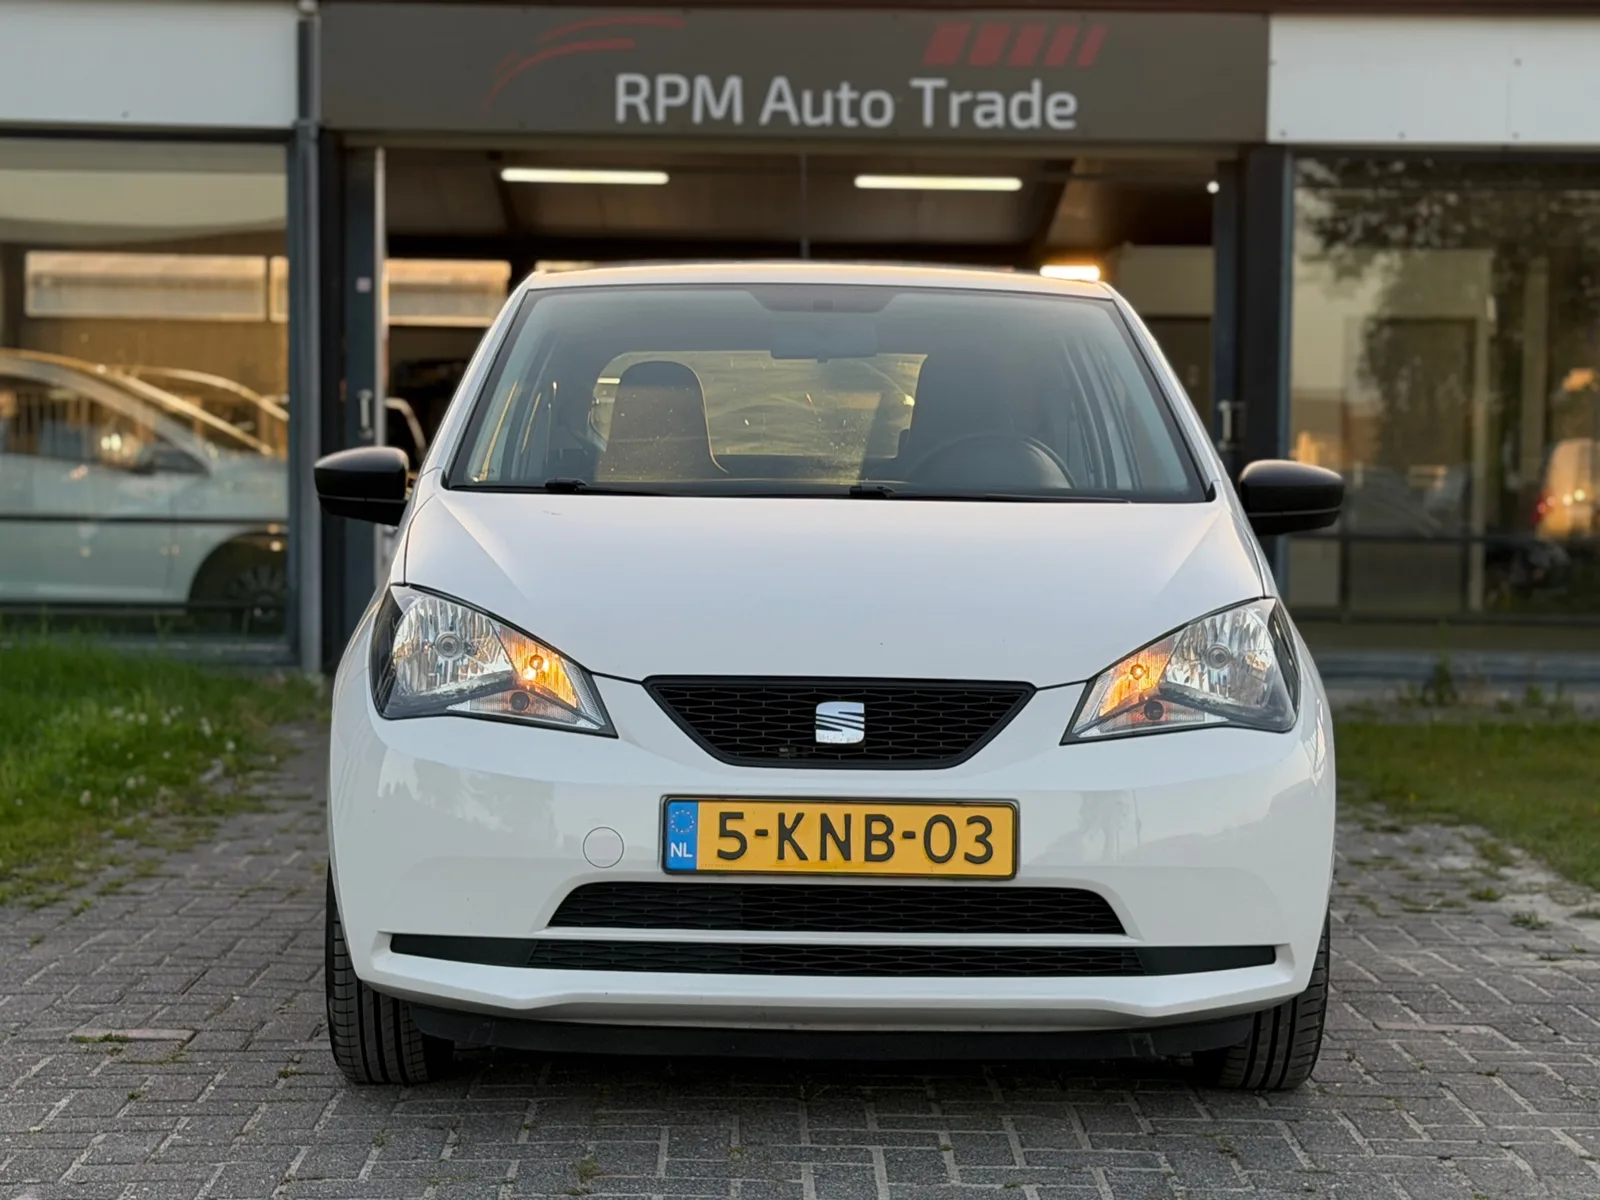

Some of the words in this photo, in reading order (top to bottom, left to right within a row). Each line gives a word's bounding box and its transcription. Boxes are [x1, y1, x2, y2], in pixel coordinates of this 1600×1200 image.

[614, 72, 743, 124] RPM
[759, 75, 895, 128] Auto
[910, 78, 1078, 130] Trade
[670, 841, 693, 858] NL
[716, 811, 994, 864] 5-KNB-03
